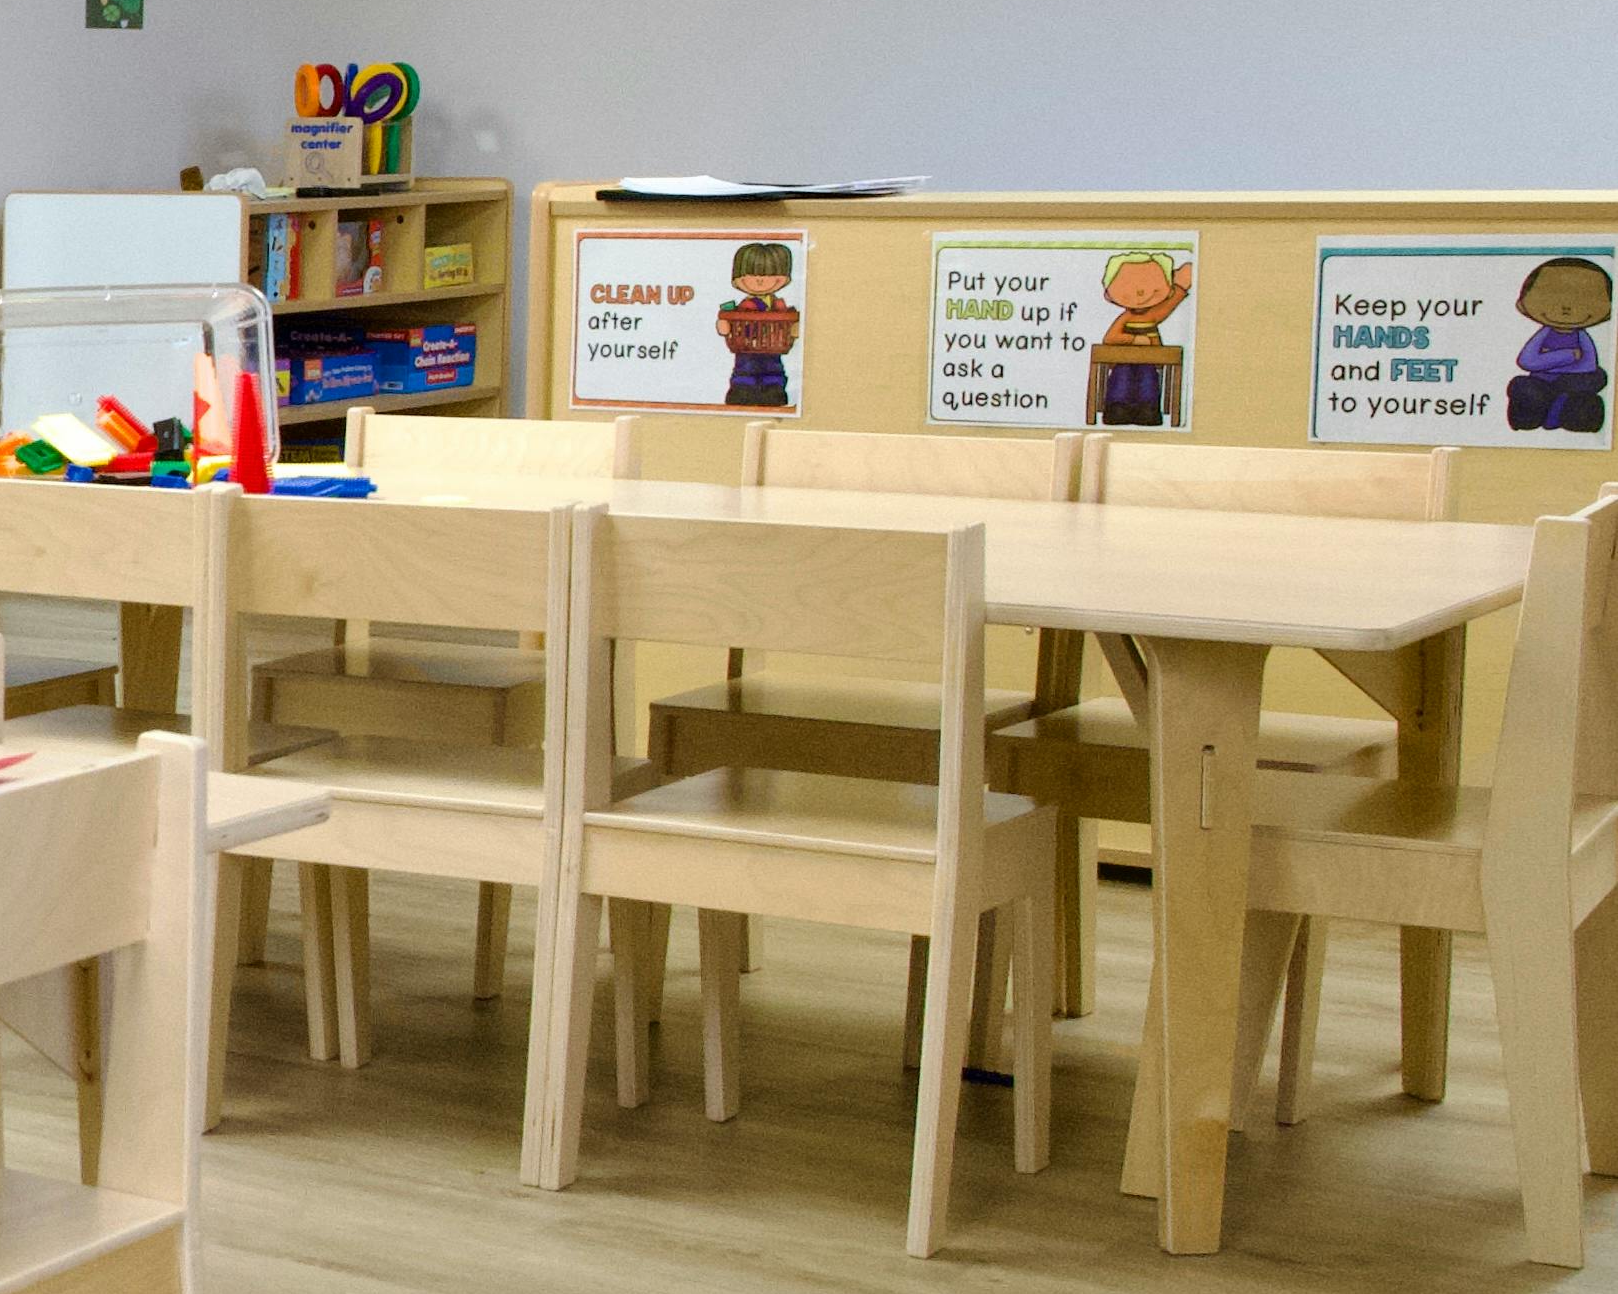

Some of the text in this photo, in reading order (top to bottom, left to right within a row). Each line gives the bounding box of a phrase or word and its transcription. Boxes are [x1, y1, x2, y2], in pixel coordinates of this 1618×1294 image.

[290, 121, 354, 137] magnifier
[300, 137, 343, 151] center
[589, 283, 695, 306] CLEAN UP
[947, 271, 1050, 297] Put your
[945, 298, 1079, 326] HAND up if
[1334, 293, 1483, 322] Keep your
[588, 313, 643, 332] after
[943, 332, 1086, 353] you want to
[1332, 324, 1430, 350] HANDS
[587, 340, 680, 362] yourself
[943, 358, 1005, 380] ask a
[1330, 358, 1459, 383] and FEET
[942, 388, 1048, 411] question
[1328, 392, 1491, 419] to yourself
